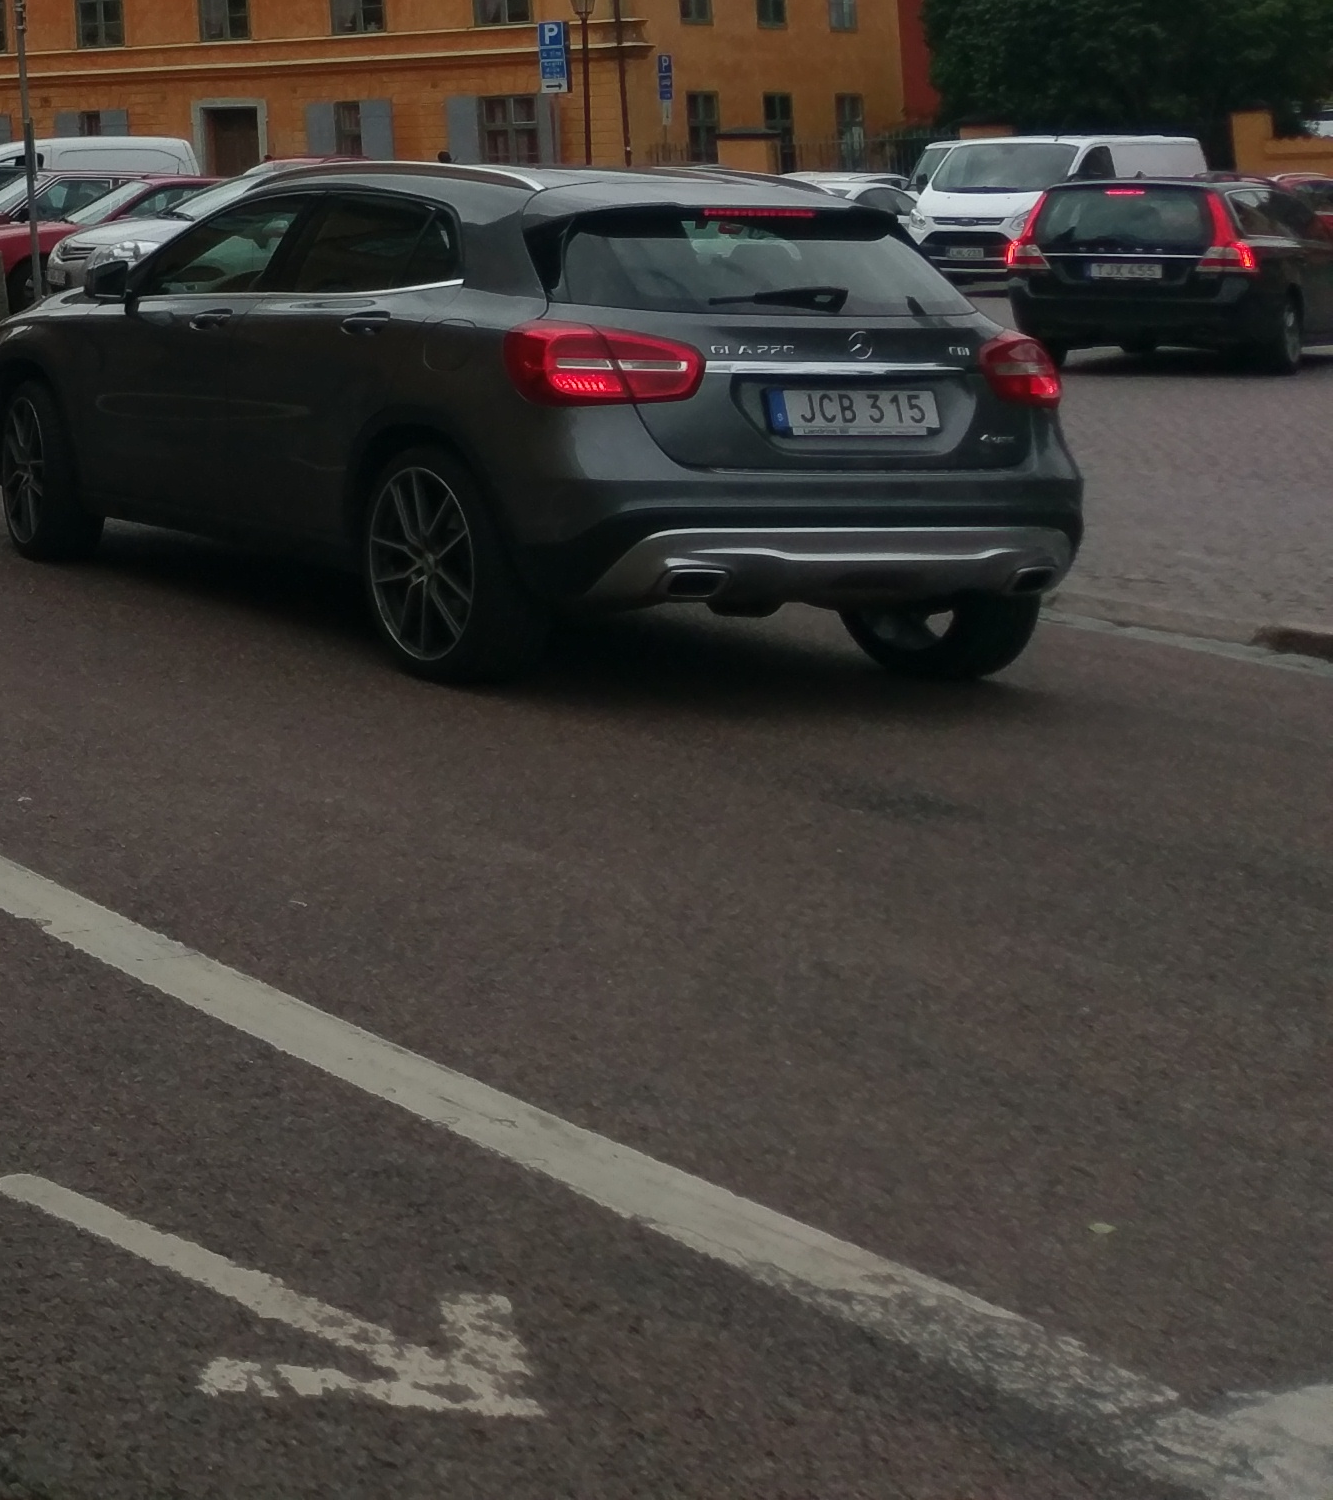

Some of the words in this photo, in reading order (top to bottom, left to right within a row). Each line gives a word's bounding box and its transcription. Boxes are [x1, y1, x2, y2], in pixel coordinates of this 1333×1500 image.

[544, 23, 558, 45] P
[661, 56, 669, 71] P
[800, 393, 857, 424] JCB
[866, 394, 926, 424] 315
